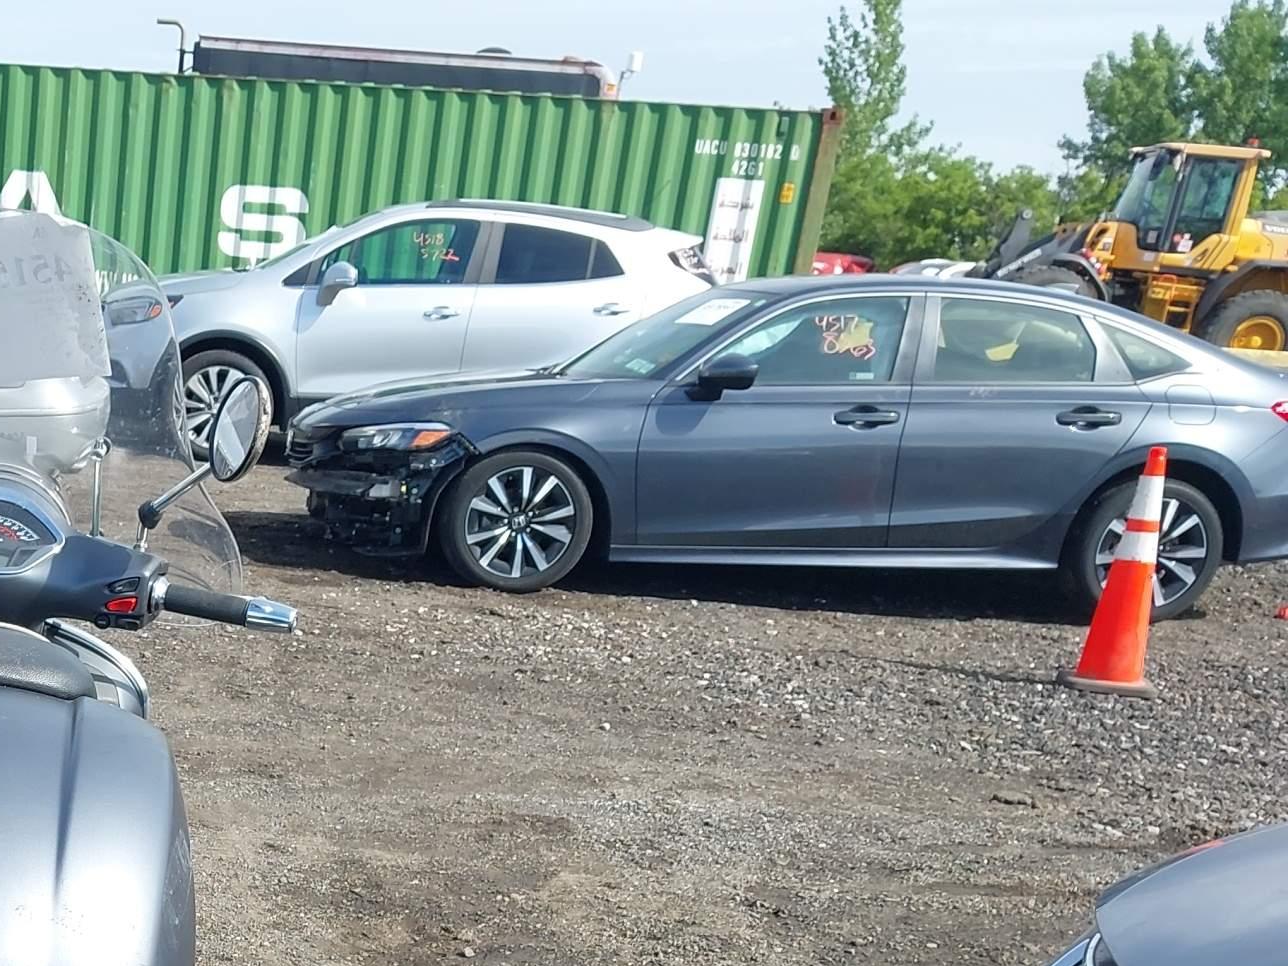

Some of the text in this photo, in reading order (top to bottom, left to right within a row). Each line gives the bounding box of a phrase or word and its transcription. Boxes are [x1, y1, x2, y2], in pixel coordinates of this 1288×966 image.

[694, 139, 728, 154] UACU
[733, 142, 783, 160] 830182
[815, 314, 858, 332] 4517
